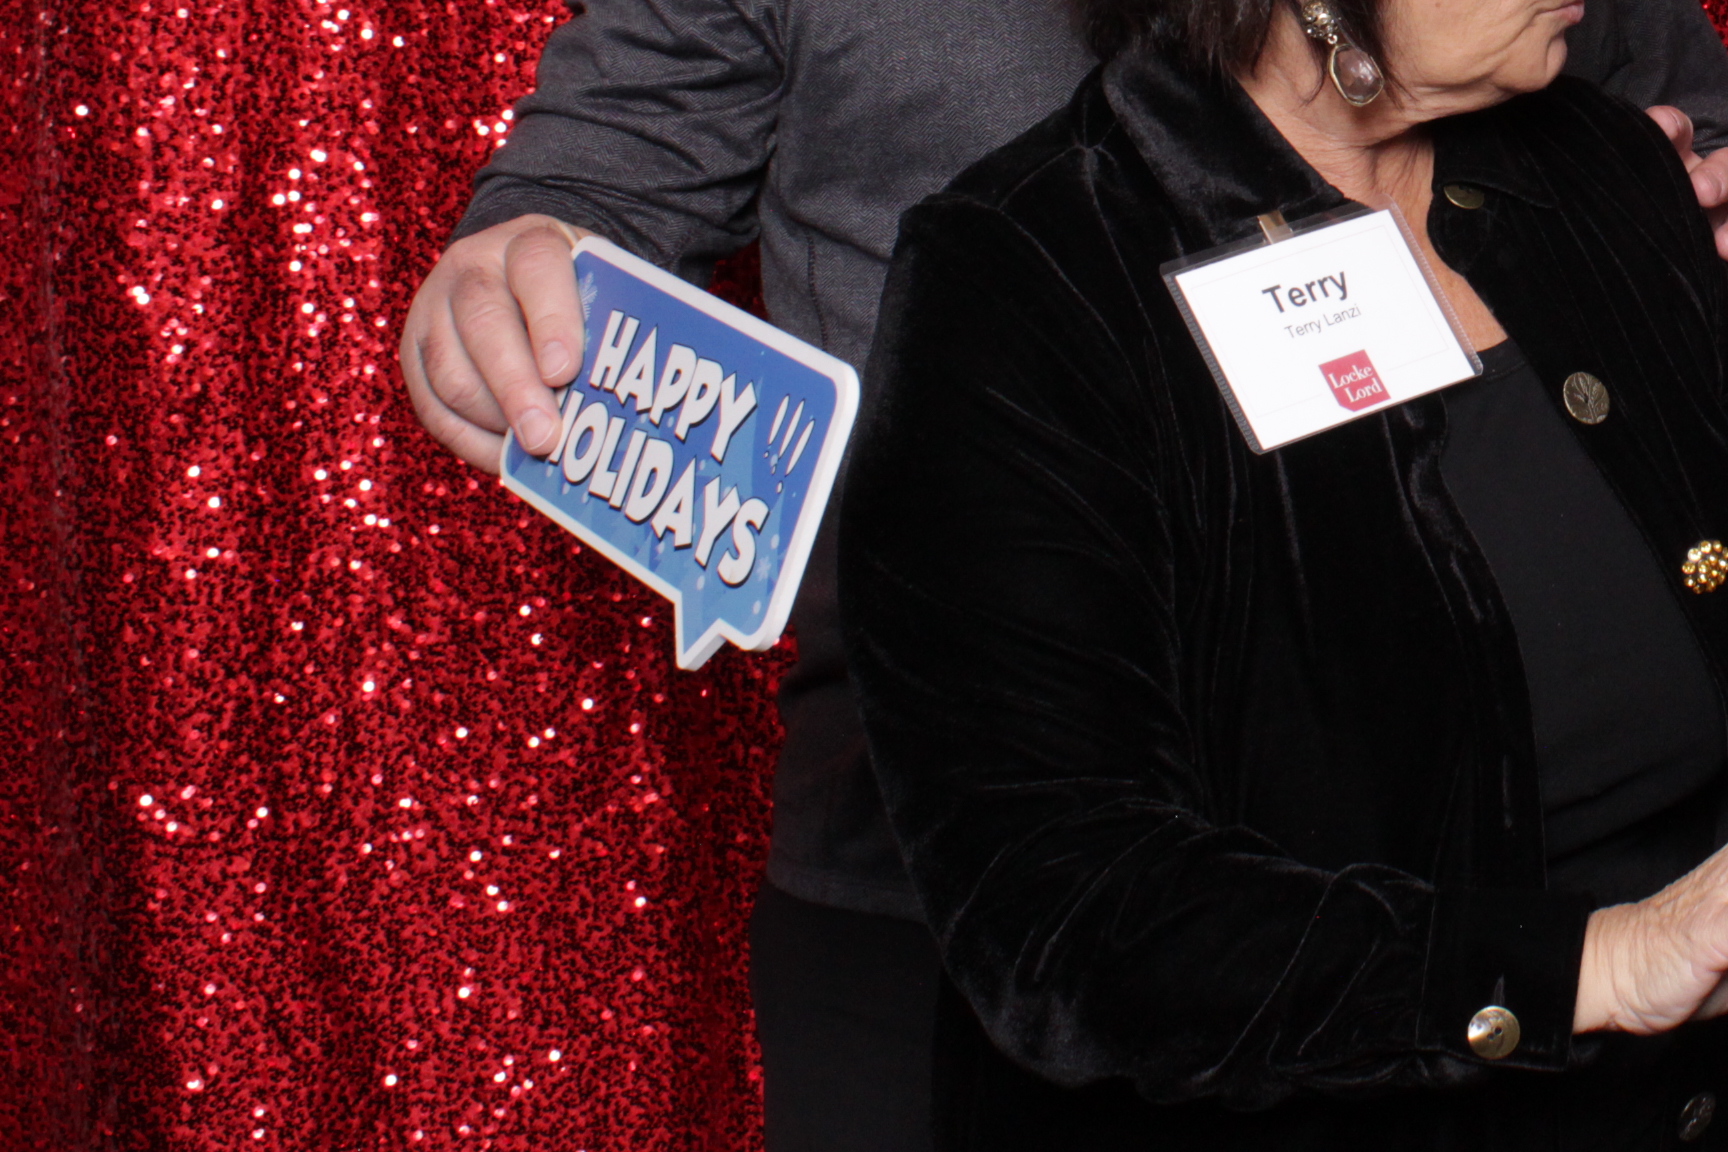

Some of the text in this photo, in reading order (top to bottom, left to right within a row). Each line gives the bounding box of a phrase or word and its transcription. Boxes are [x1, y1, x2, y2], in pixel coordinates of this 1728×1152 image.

[1261, 270, 1349, 314] Terry
[1284, 303, 1363, 339] Terry Lanzi
[588, 308, 758, 464] HAPPY
[1327, 363, 1375, 390] Locke
[1344, 378, 1383, 403] Lord
